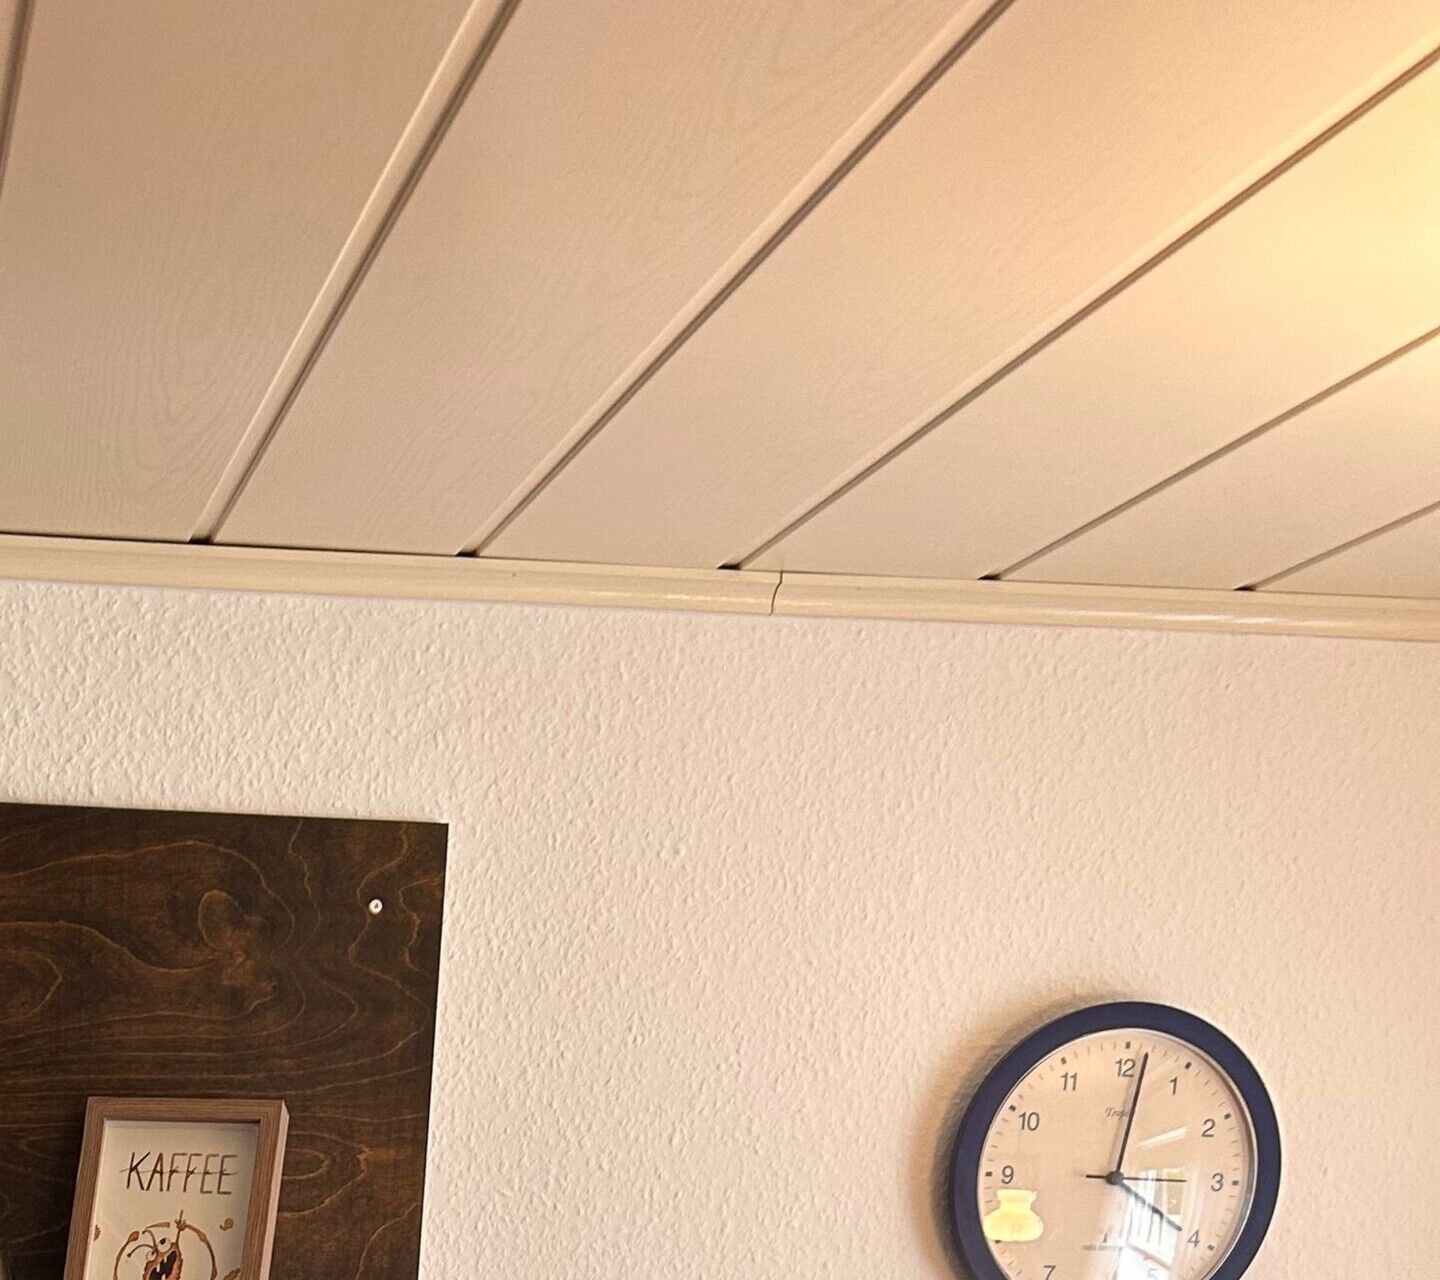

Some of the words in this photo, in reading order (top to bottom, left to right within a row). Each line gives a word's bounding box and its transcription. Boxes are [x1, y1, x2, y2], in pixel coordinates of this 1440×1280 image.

[1115, 1058, 1136, 1078] 12
[1061, 1072, 1078, 1092] 11
[1169, 1077, 1179, 1096] 1
[1018, 1112, 1040, 1132] 10
[1201, 1119, 1216, 1138] 2
[125, 1151, 239, 1195] KAFFEE
[1001, 1165, 1015, 1185] 9
[1211, 1173, 1224, 1192] 3
[1187, 1229, 1201, 1248] 4
